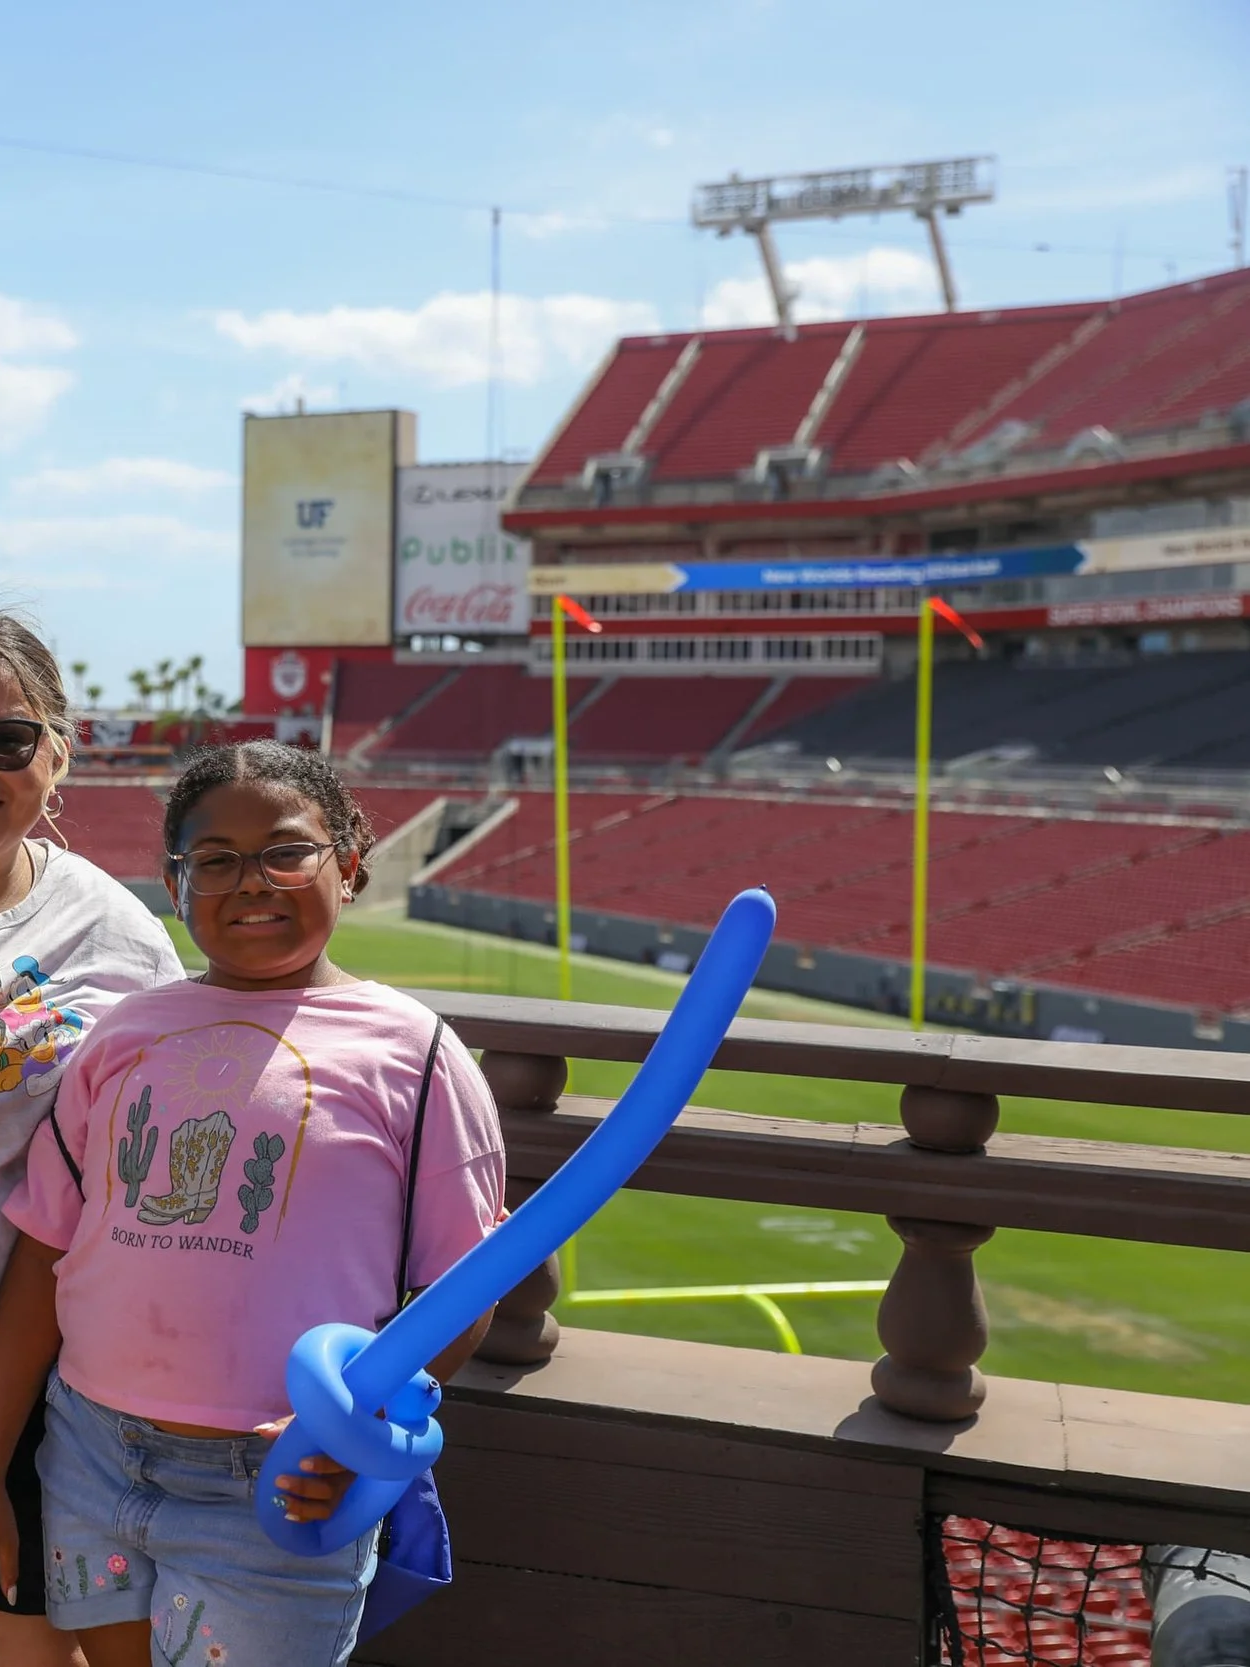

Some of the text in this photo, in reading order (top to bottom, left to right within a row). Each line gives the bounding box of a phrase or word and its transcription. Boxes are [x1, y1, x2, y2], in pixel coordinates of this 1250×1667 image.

[296, 498, 335, 529] UF
[111, 1226, 254, 1260] BORN TO WANDER
